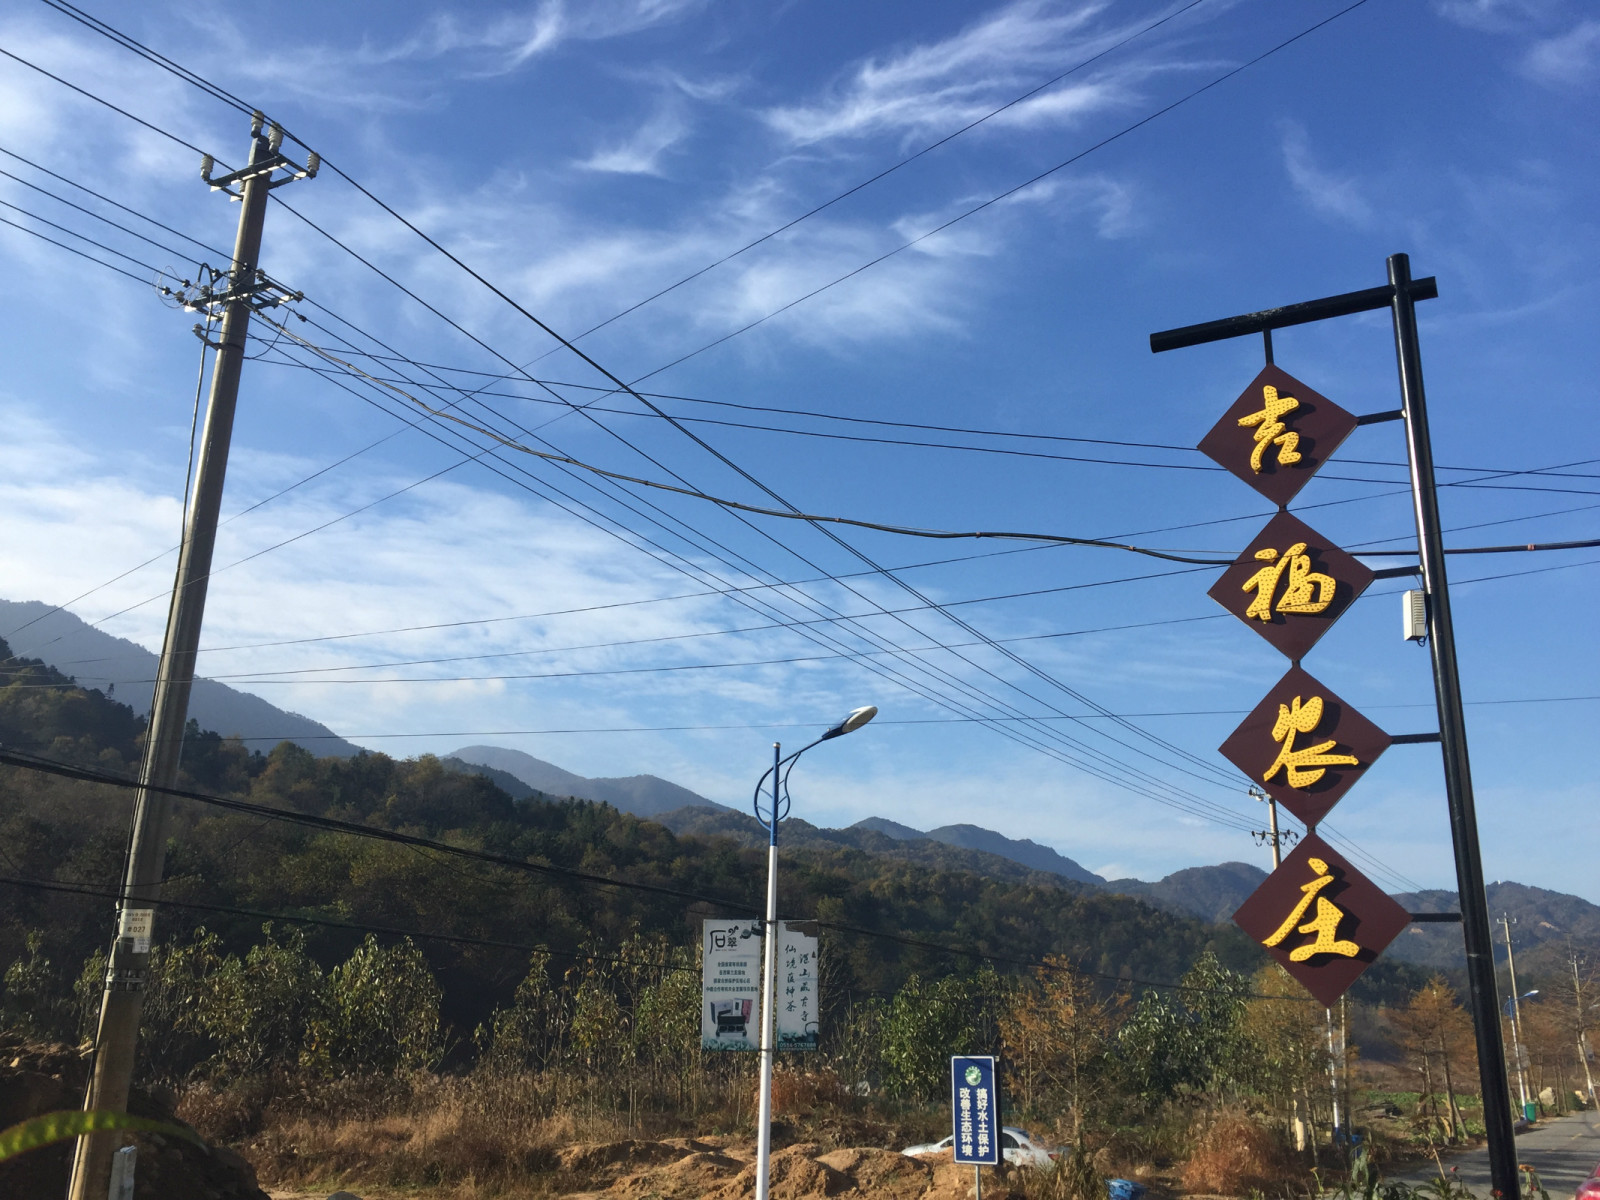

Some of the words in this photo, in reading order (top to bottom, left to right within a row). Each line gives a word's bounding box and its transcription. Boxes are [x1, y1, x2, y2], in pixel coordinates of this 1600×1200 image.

[959, 1087, 973, 1157] 改善生态环境
[976, 1088, 990, 1157] 搞好水土保护
